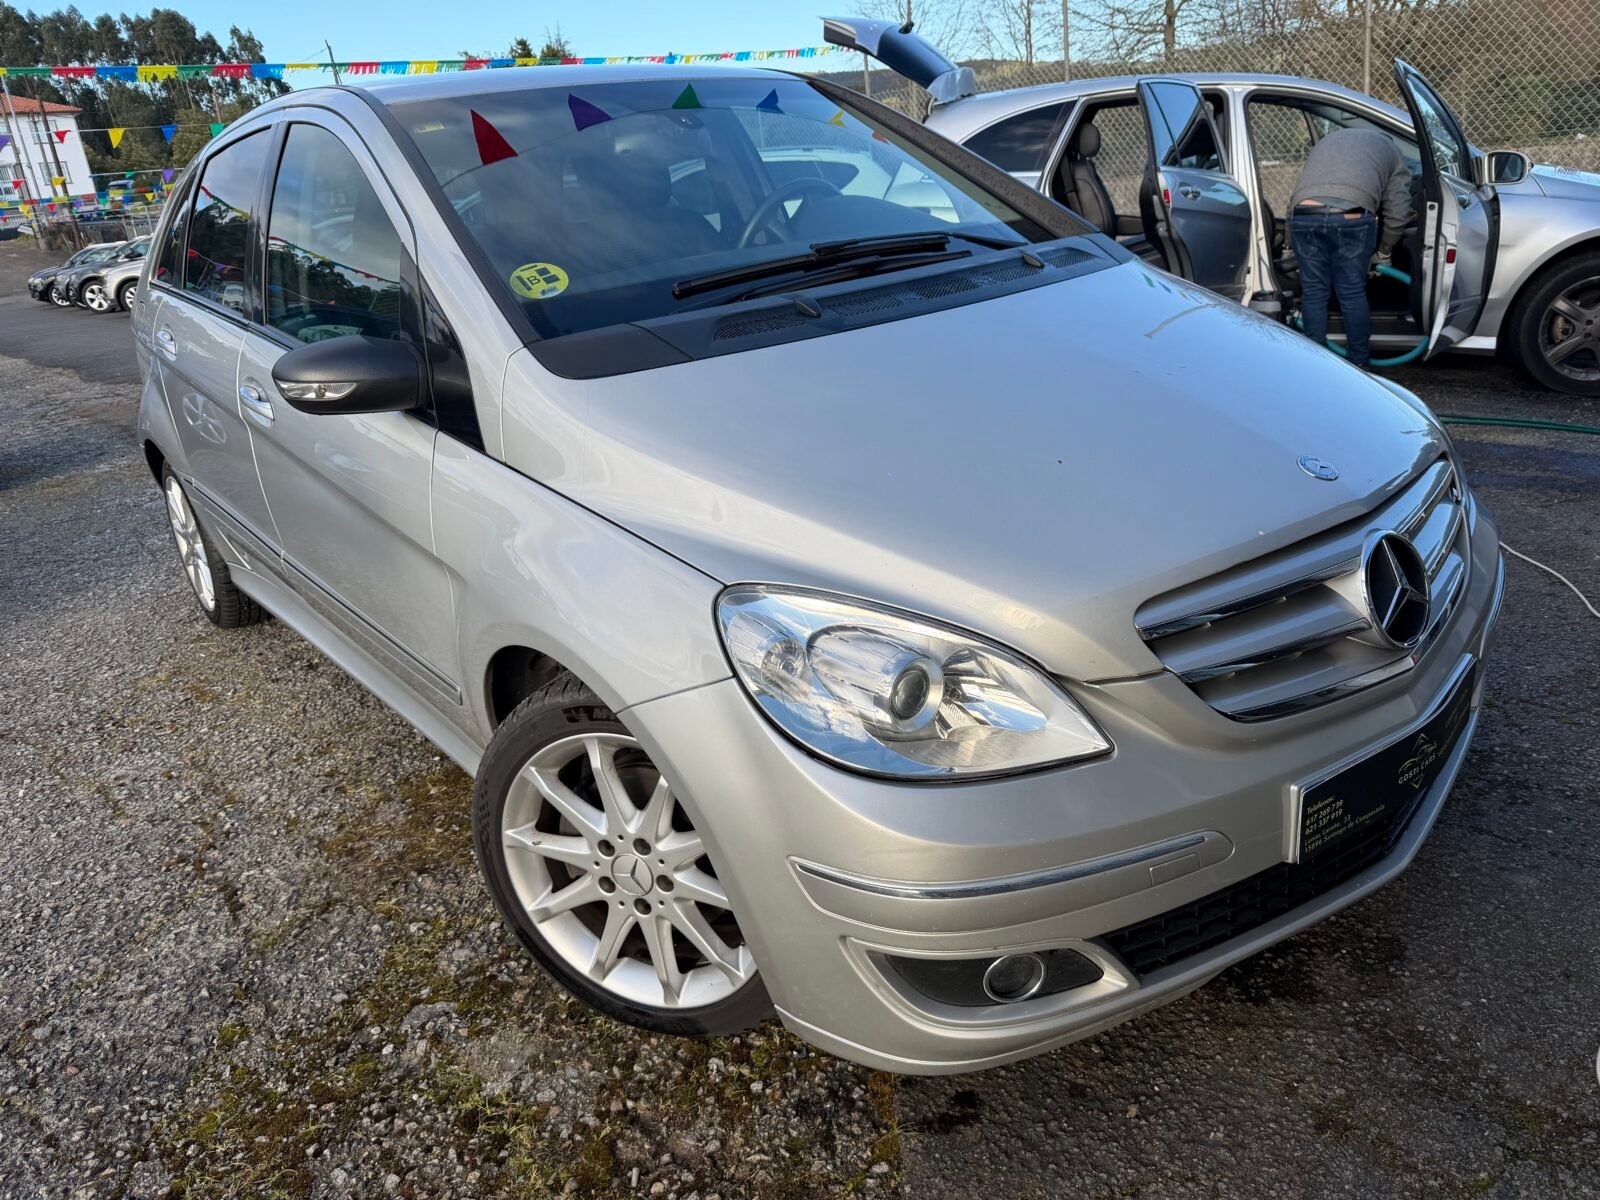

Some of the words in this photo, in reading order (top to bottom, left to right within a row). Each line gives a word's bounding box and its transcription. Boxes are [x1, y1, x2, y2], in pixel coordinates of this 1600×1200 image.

[527, 275, 541, 285] B
[1398, 766, 1419, 785] GOSTI
[1420, 752, 1436, 770] CARS
[1305, 814, 1318, 826] 617
[1319, 806, 1331, 819] 269
[1331, 800, 1344, 812] 739
[1305, 823, 1317, 835] 621
[1330, 808, 1343, 820] 919
